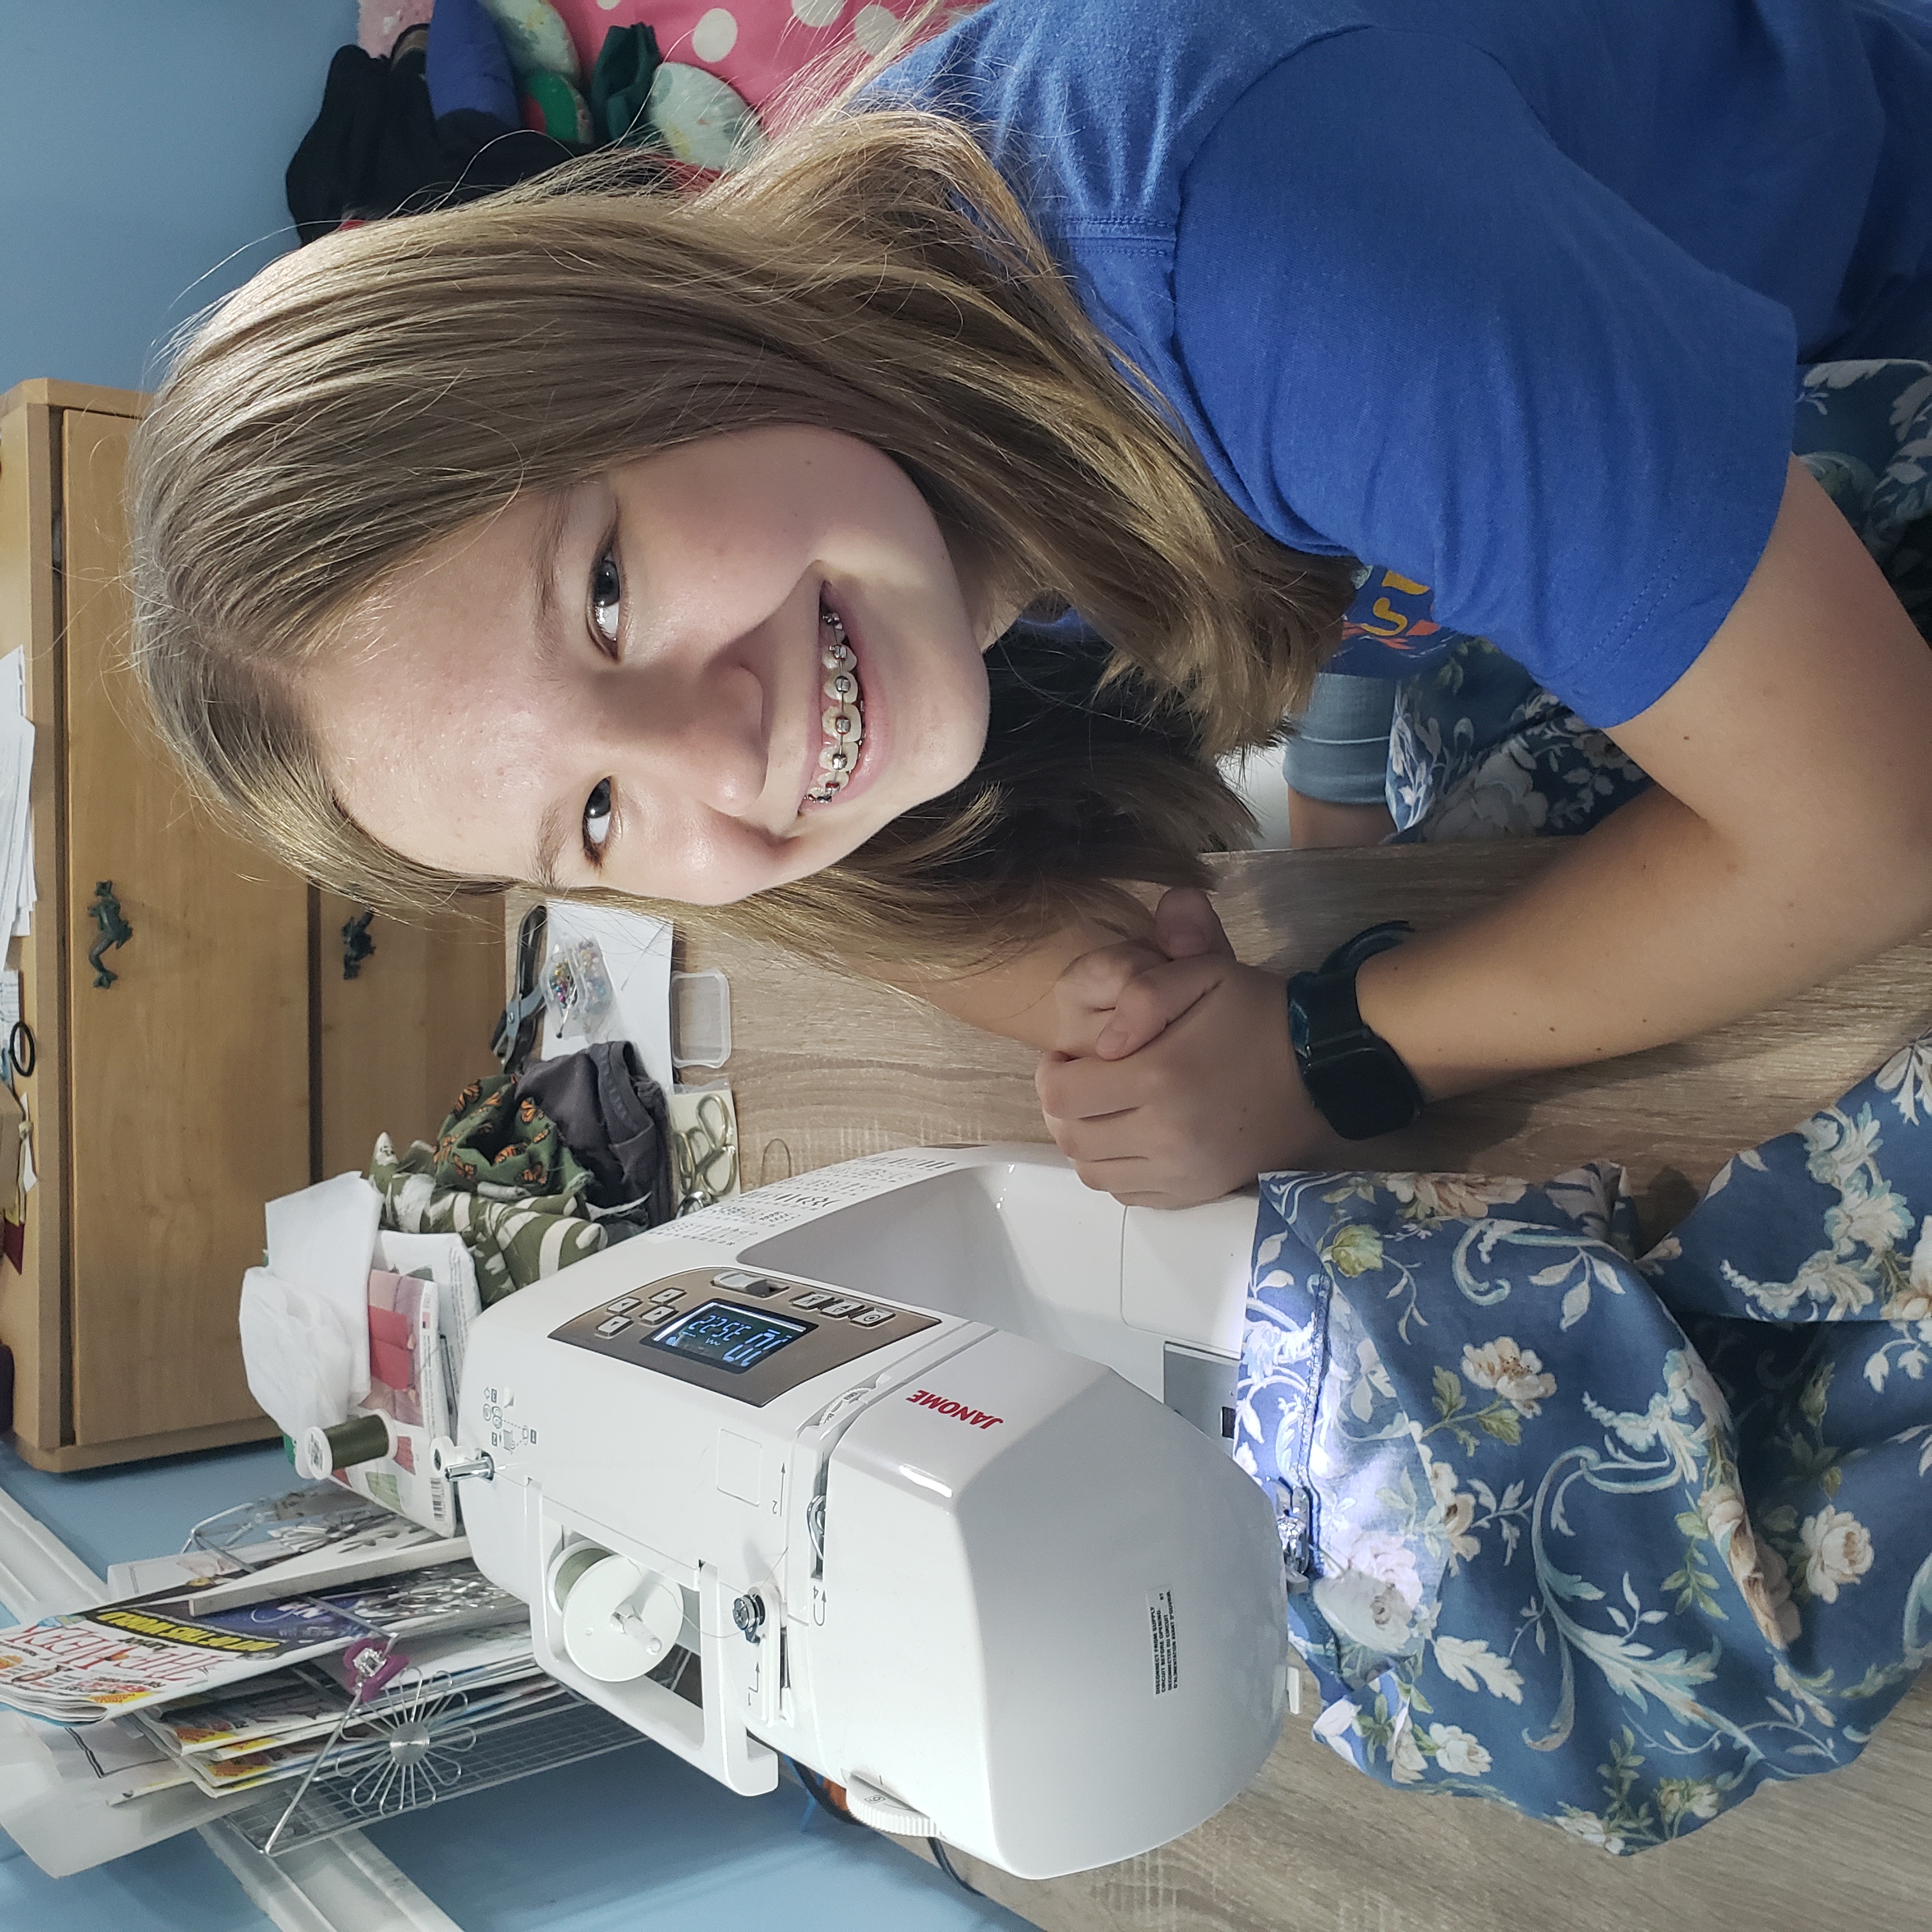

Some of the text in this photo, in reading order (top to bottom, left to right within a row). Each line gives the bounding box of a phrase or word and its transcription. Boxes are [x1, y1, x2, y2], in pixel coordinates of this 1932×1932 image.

[905, 1389, 1004, 1430] JANOME
[771, 1500, 778, 1515] 2
[813, 1584, 820, 1599] 4
[96, 1611, 280, 1652] OUT OF THIS WORLD
[4, 1625, 139, 1669] WEEK
[1166, 1638, 1170, 1648] DU
[114, 1652, 232, 1681] THE
[747, 1692, 751, 1706] 1
